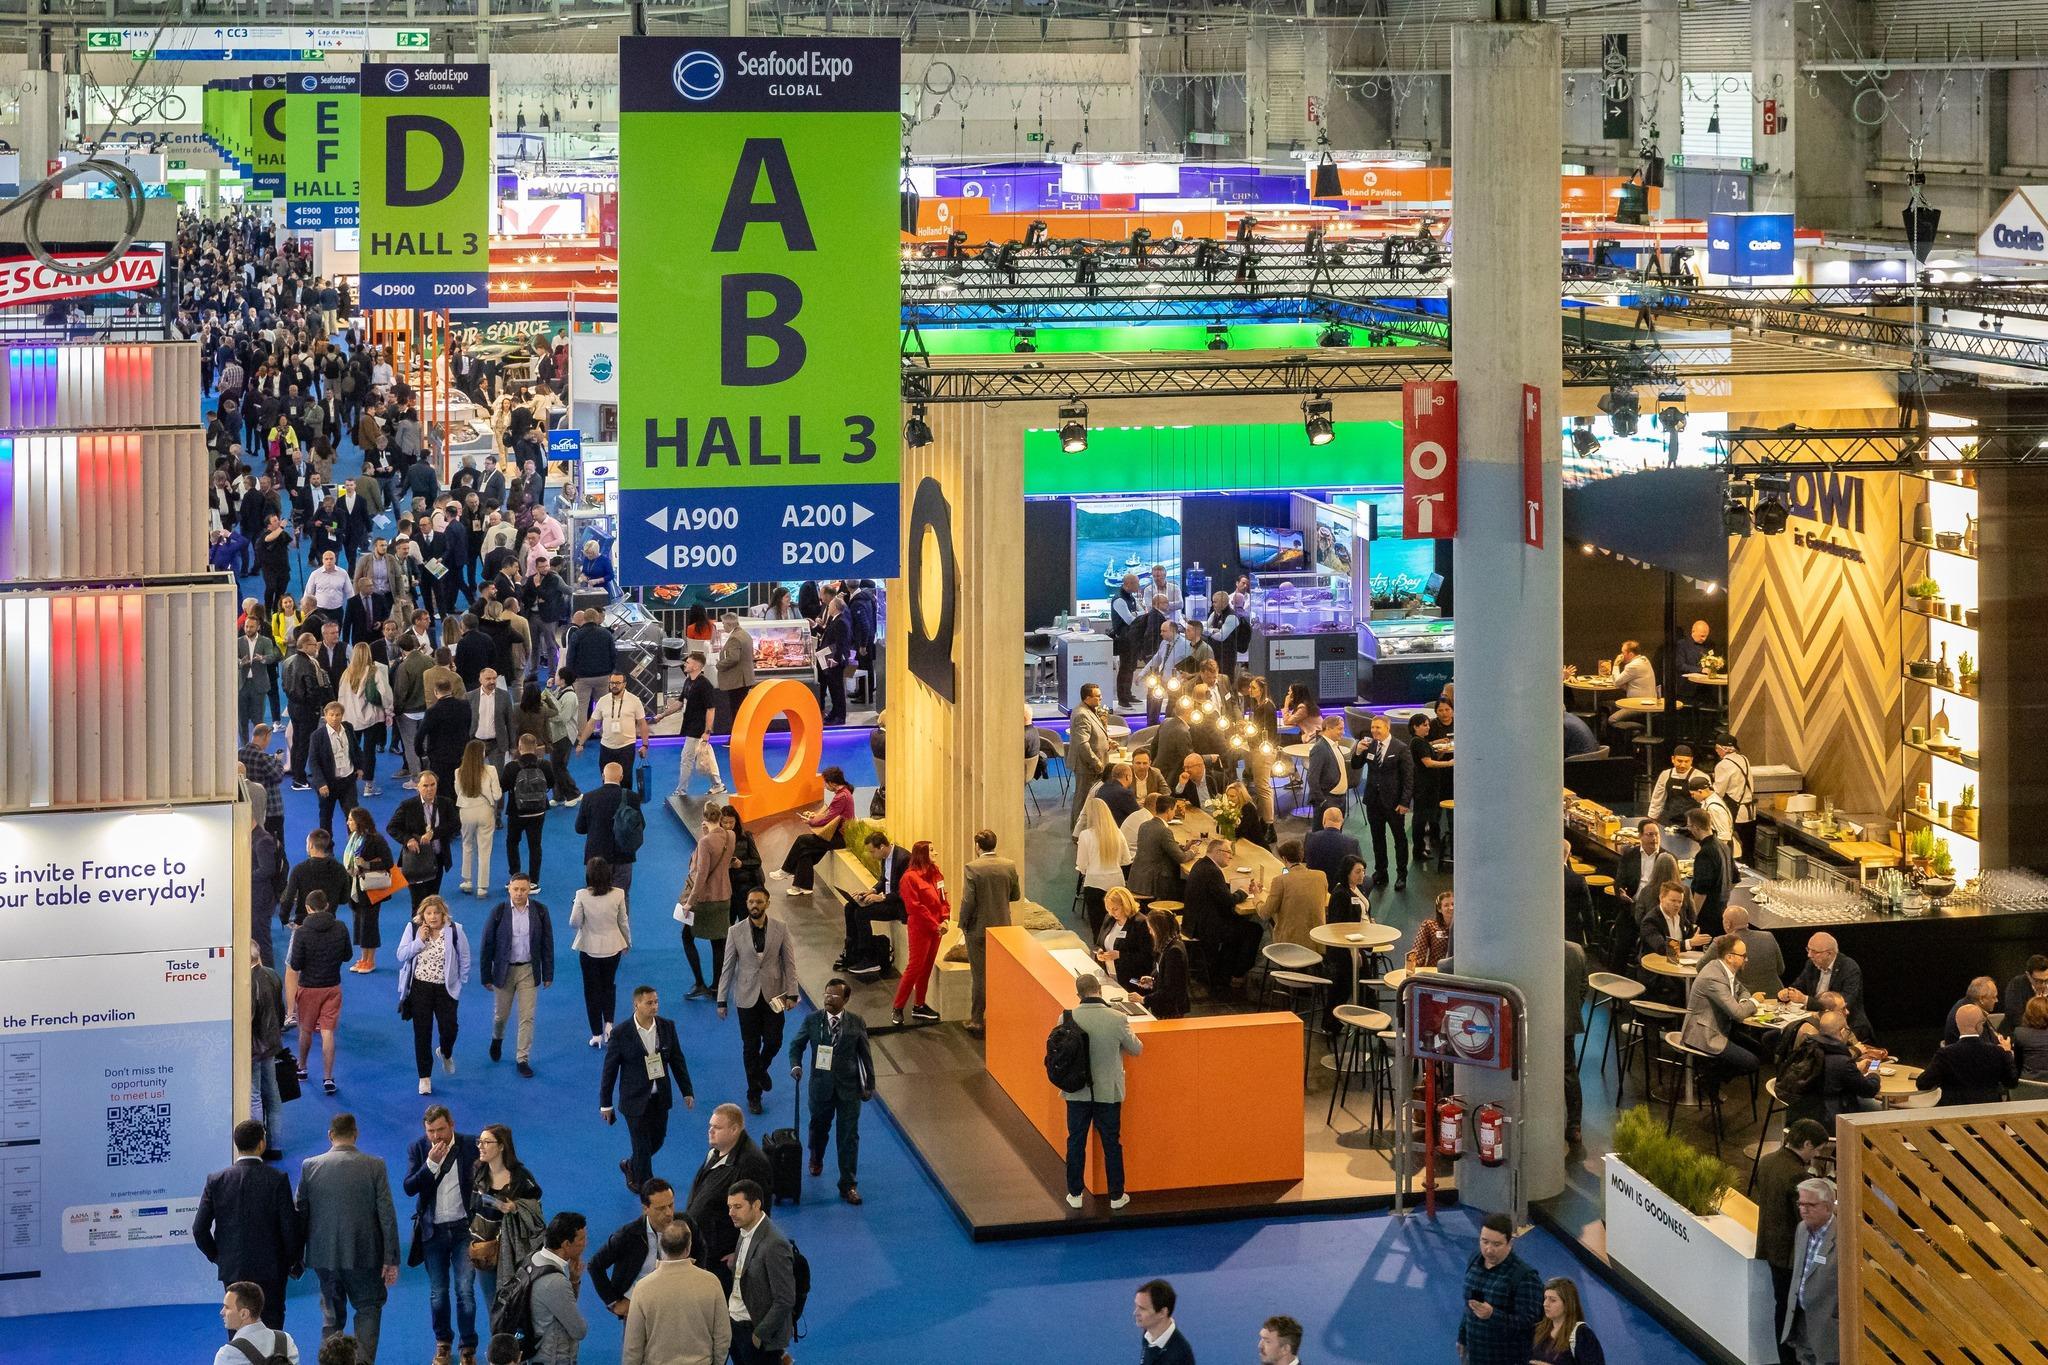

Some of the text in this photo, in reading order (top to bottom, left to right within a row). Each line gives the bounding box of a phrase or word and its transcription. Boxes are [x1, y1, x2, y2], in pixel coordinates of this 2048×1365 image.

[227, 29, 248, 38] CC3
[318, 29, 328, 37] Cap
[738, 51, 853, 82] Seafood Expo
[320, 75, 356, 86] Seafood Expo
[414, 68, 469, 83] Seafood Expo
[769, 85, 822, 96] GLOBAL
[317, 101, 339, 134] E
[317, 140, 339, 173] F
[386, 114, 465, 207] D
[294, 181, 346, 196] HALL
[710, 137, 818, 252] A
[1371, 189, 1402, 197] Pavilion
[302, 206, 353, 215] E900 E200
[334, 217, 353, 225] F100
[918, 226, 942, 237] Holland
[1994, 223, 2044, 251] Cooke
[371, 232, 478, 256] HALL 3
[384, 284, 465, 296] D900 D200
[487, 320, 551, 341] SOURCE
[721, 273, 807, 387] B
[645, 415, 877, 468] HALL 3
[1765, 471, 1865, 534] OWI
[673, 504, 846, 531] A900 A200
[673, 541, 845, 568] B900 B200
[14, 863, 75, 884] invite
[82, 860, 156, 880] France
[163, 857, 186, 875] to
[35, 884, 91, 907] table
[98, 878, 205, 906] everyday!
[166, 960, 200, 970] Taste
[165, 971, 207, 982] France
[3, 1009, 136, 1028] the French pavilion
[104, 1065, 173, 1078] Don't miss the
[111, 1077, 167, 1090] opportunity
[110, 1090, 165, 1102] to meet us!
[118, 1189, 151, 1198] partnership
[1611, 1173, 1690, 1243] MOWI IS GOODNESS.
